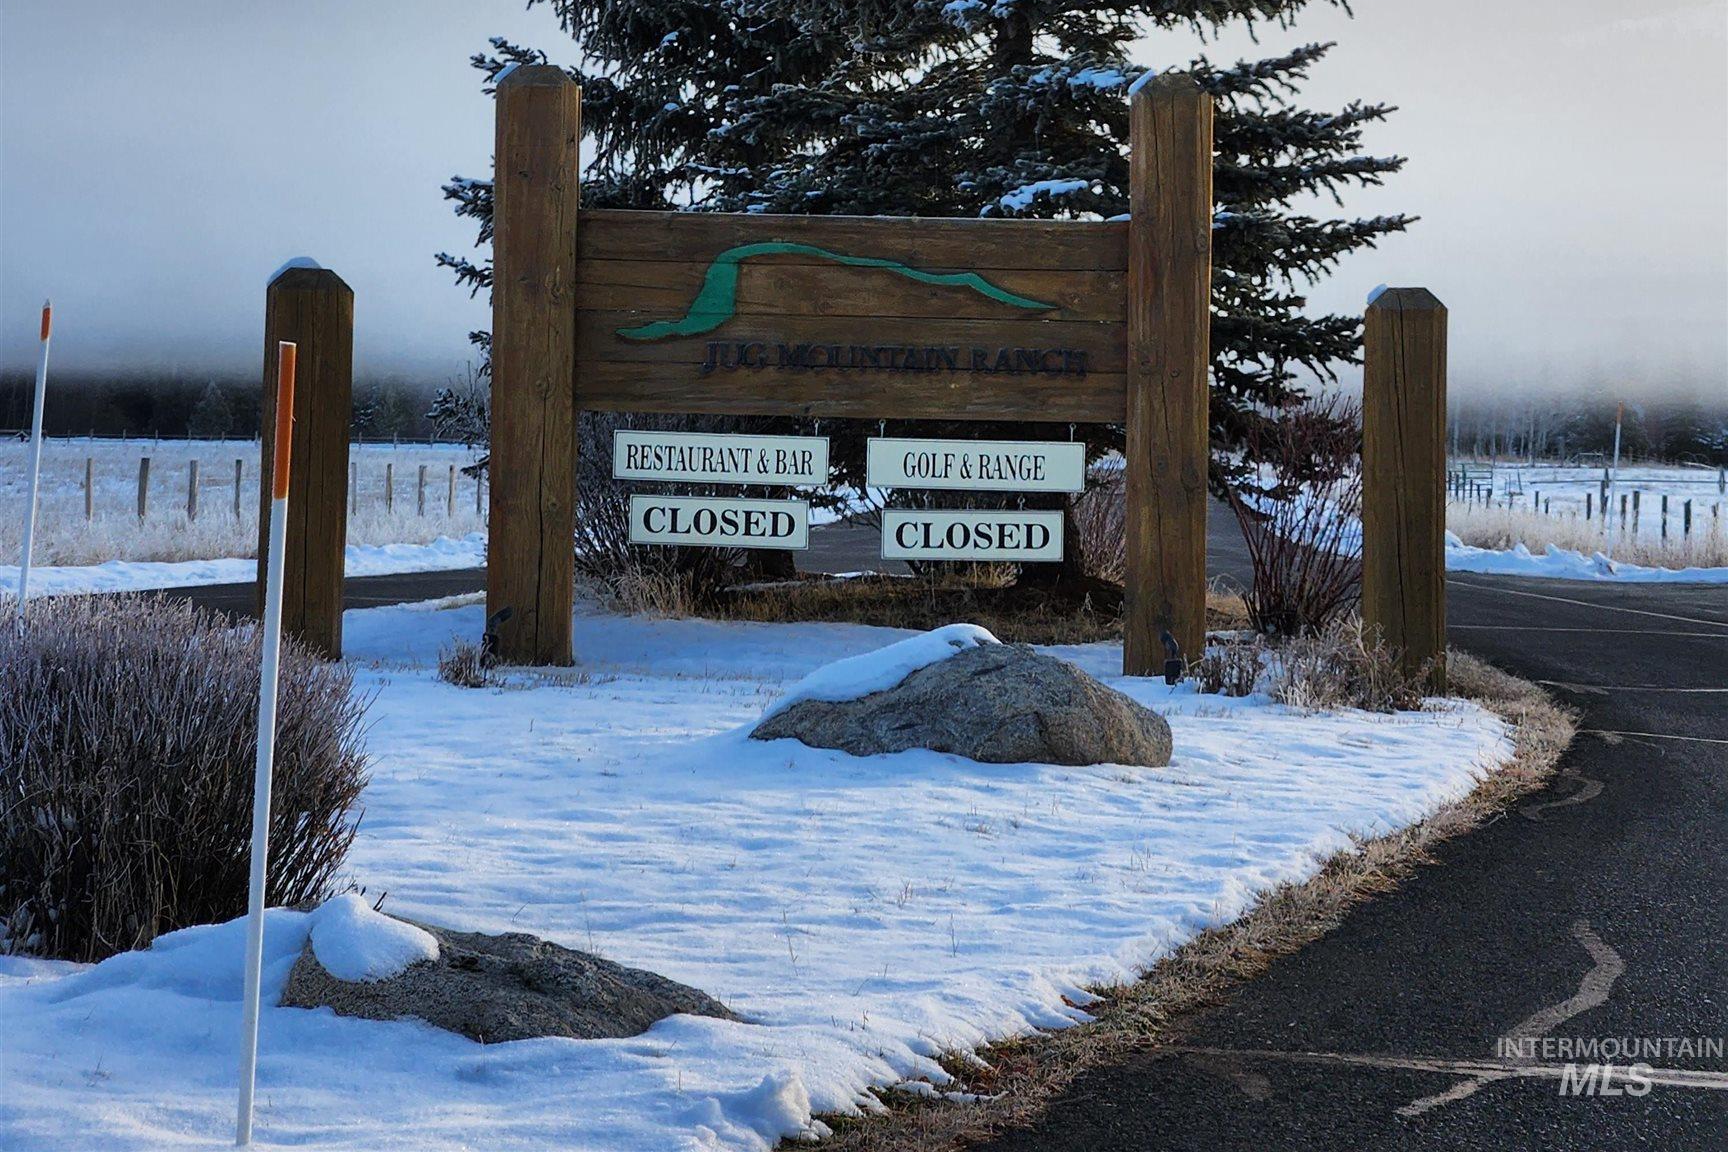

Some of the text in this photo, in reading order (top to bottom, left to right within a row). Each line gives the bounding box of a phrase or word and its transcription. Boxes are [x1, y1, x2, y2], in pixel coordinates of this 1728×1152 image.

[701, 341, 1087, 377] JUG MOUNTAIN RANCH
[625, 444, 814, 476] RESTAURANT & BAR
[902, 451, 1046, 481] GOLF & RANGE
[642, 505, 796, 538] CLOSED
[894, 521, 1051, 550] CLOSED
